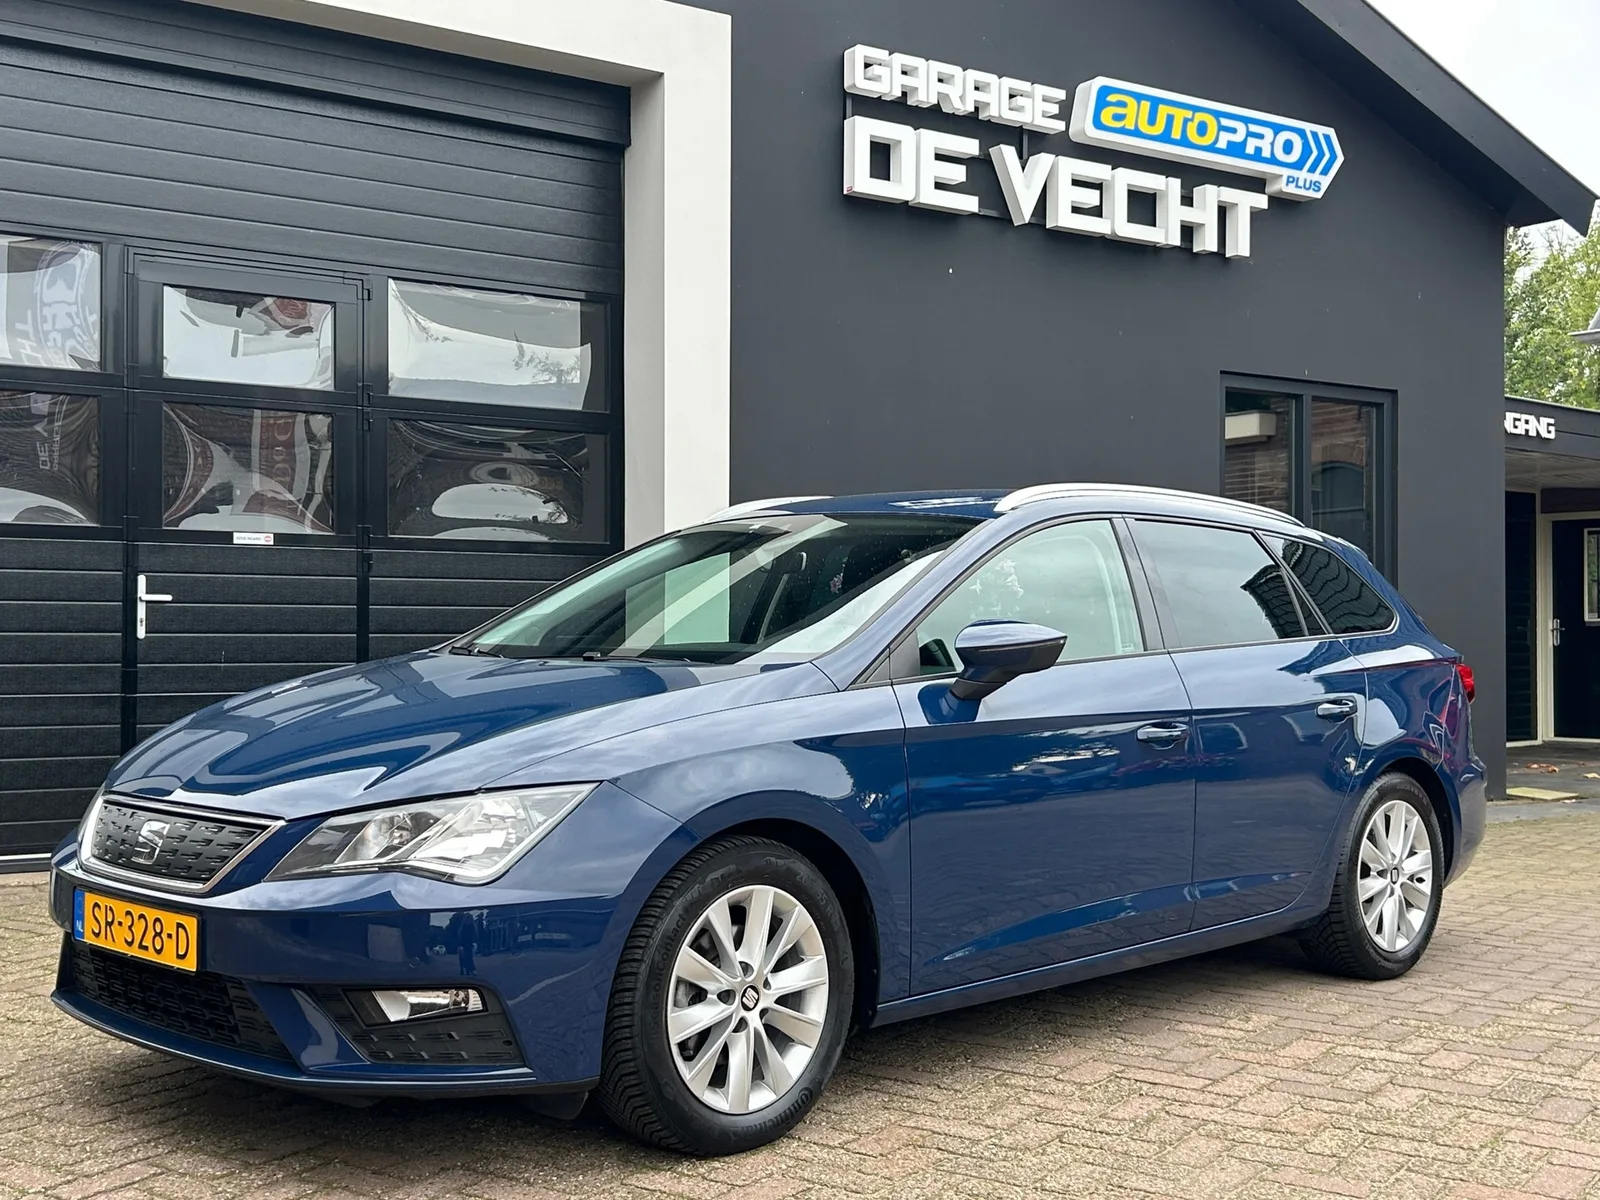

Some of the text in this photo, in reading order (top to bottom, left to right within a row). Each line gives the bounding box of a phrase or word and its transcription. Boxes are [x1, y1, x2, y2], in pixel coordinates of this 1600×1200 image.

[844, 44, 1066, 134] GARAGE
[844, 115, 1268, 258] DE VECHT
[1285, 175, 1322, 193] PLUS
[75, 919, 84, 932] NL
[91, 901, 190, 960] SR-328-D
